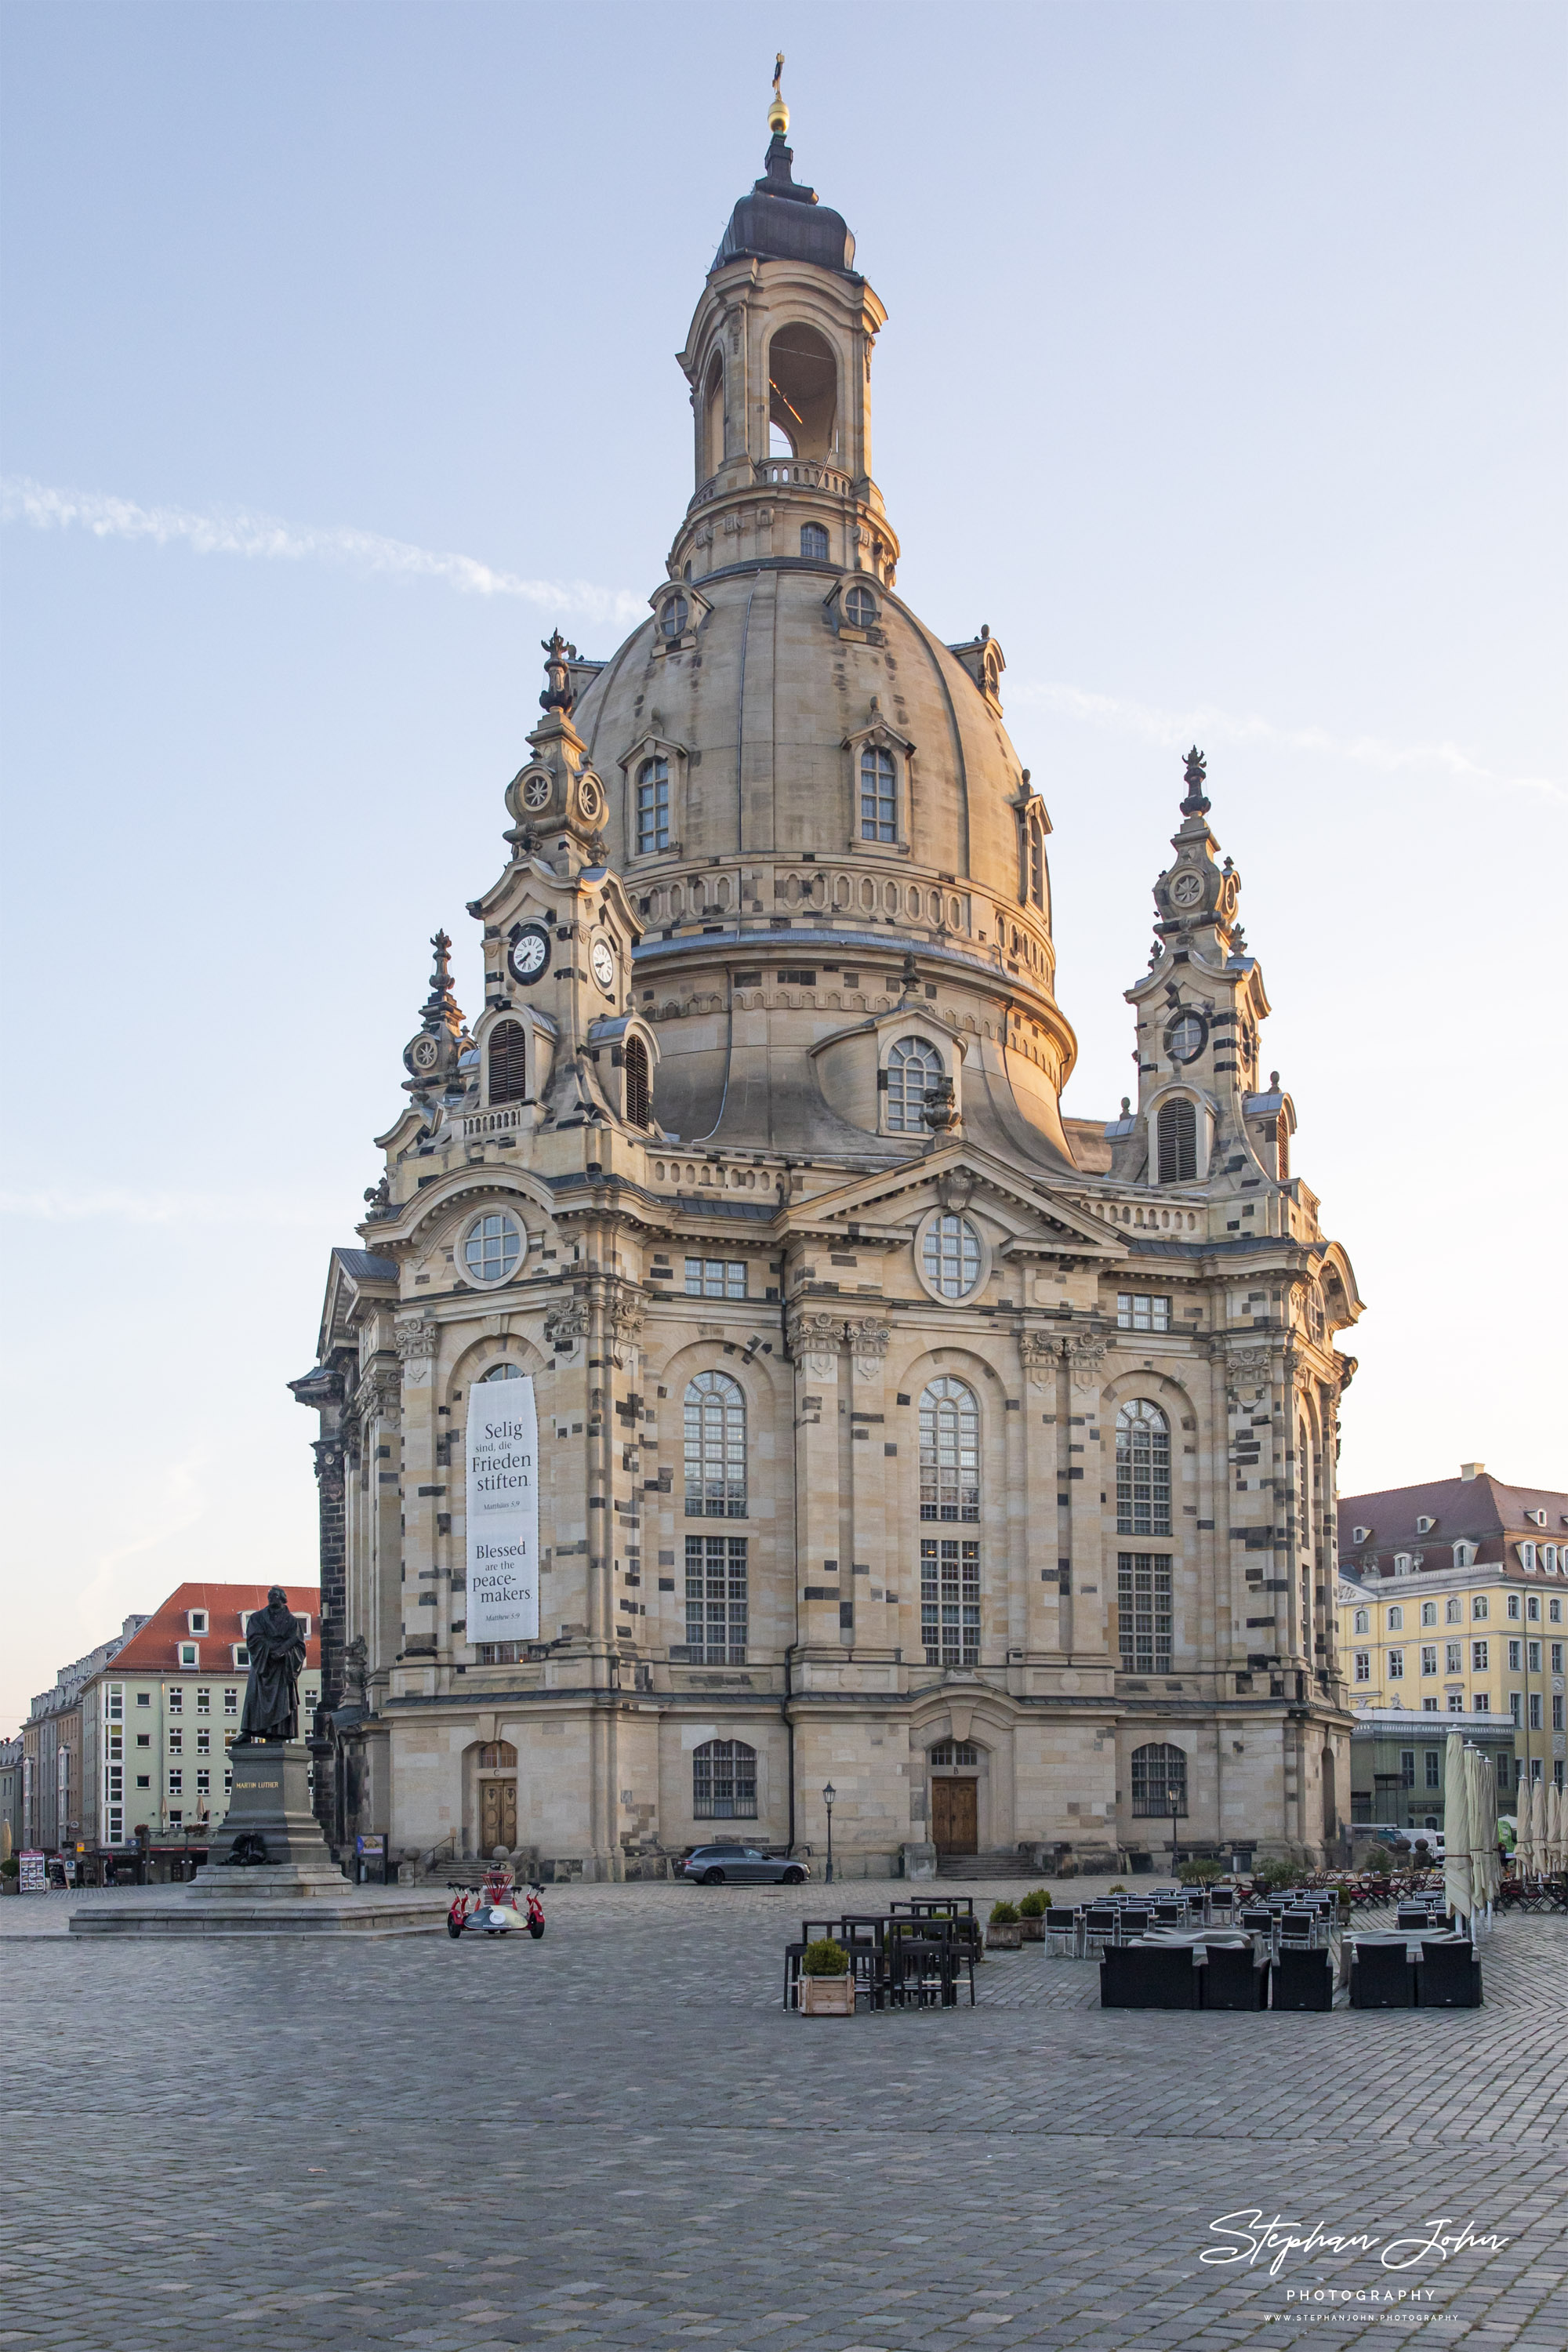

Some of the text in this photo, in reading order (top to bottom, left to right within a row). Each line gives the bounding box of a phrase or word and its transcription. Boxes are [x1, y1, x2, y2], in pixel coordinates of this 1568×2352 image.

[485, 1421, 523, 1440] Selig
[475, 1441, 512, 1453] sind, die
[472, 1453, 532, 1472] Frieden
[477, 1473, 532, 1492] stiften.
[477, 1541, 526, 1559] Blessed
[501, 1561, 515, 1570] the
[473, 1574, 517, 1592] peace-
[481, 1588, 533, 1603] makers.
